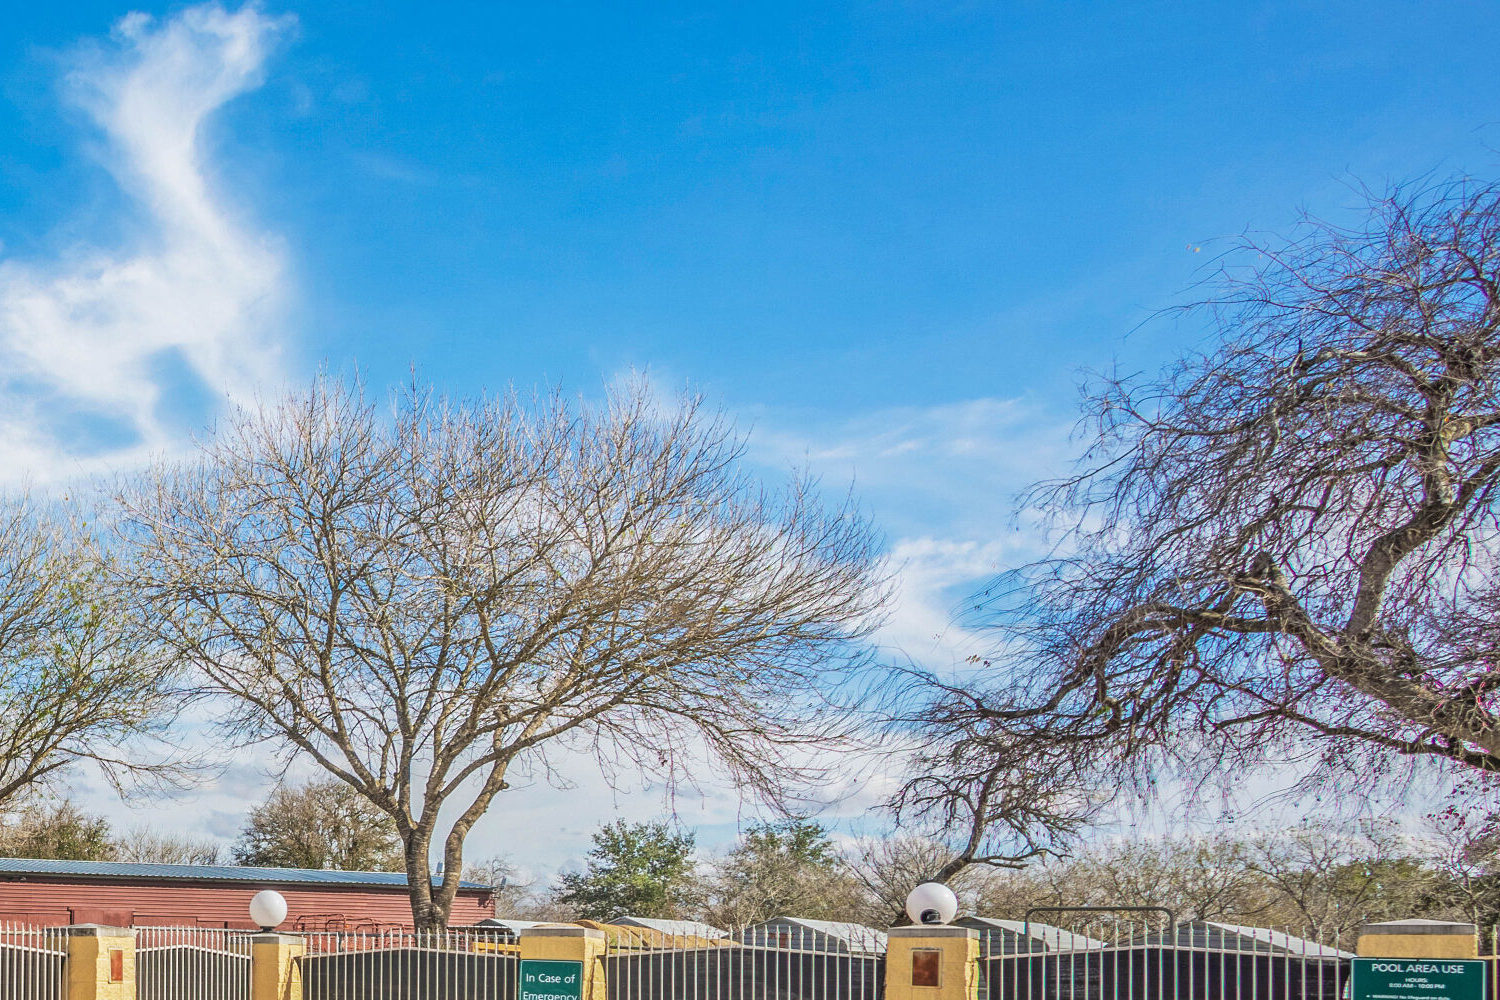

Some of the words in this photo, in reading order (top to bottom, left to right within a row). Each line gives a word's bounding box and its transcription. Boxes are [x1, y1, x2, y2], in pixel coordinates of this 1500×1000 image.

[1372, 963, 1404, 972] POOL
[1405, 964, 1439, 973] AREA
[1442, 965, 1464, 974] USE
[526, 973, 535, 982] In
[538, 973, 561, 983] Case
[564, 974, 575, 983] of
